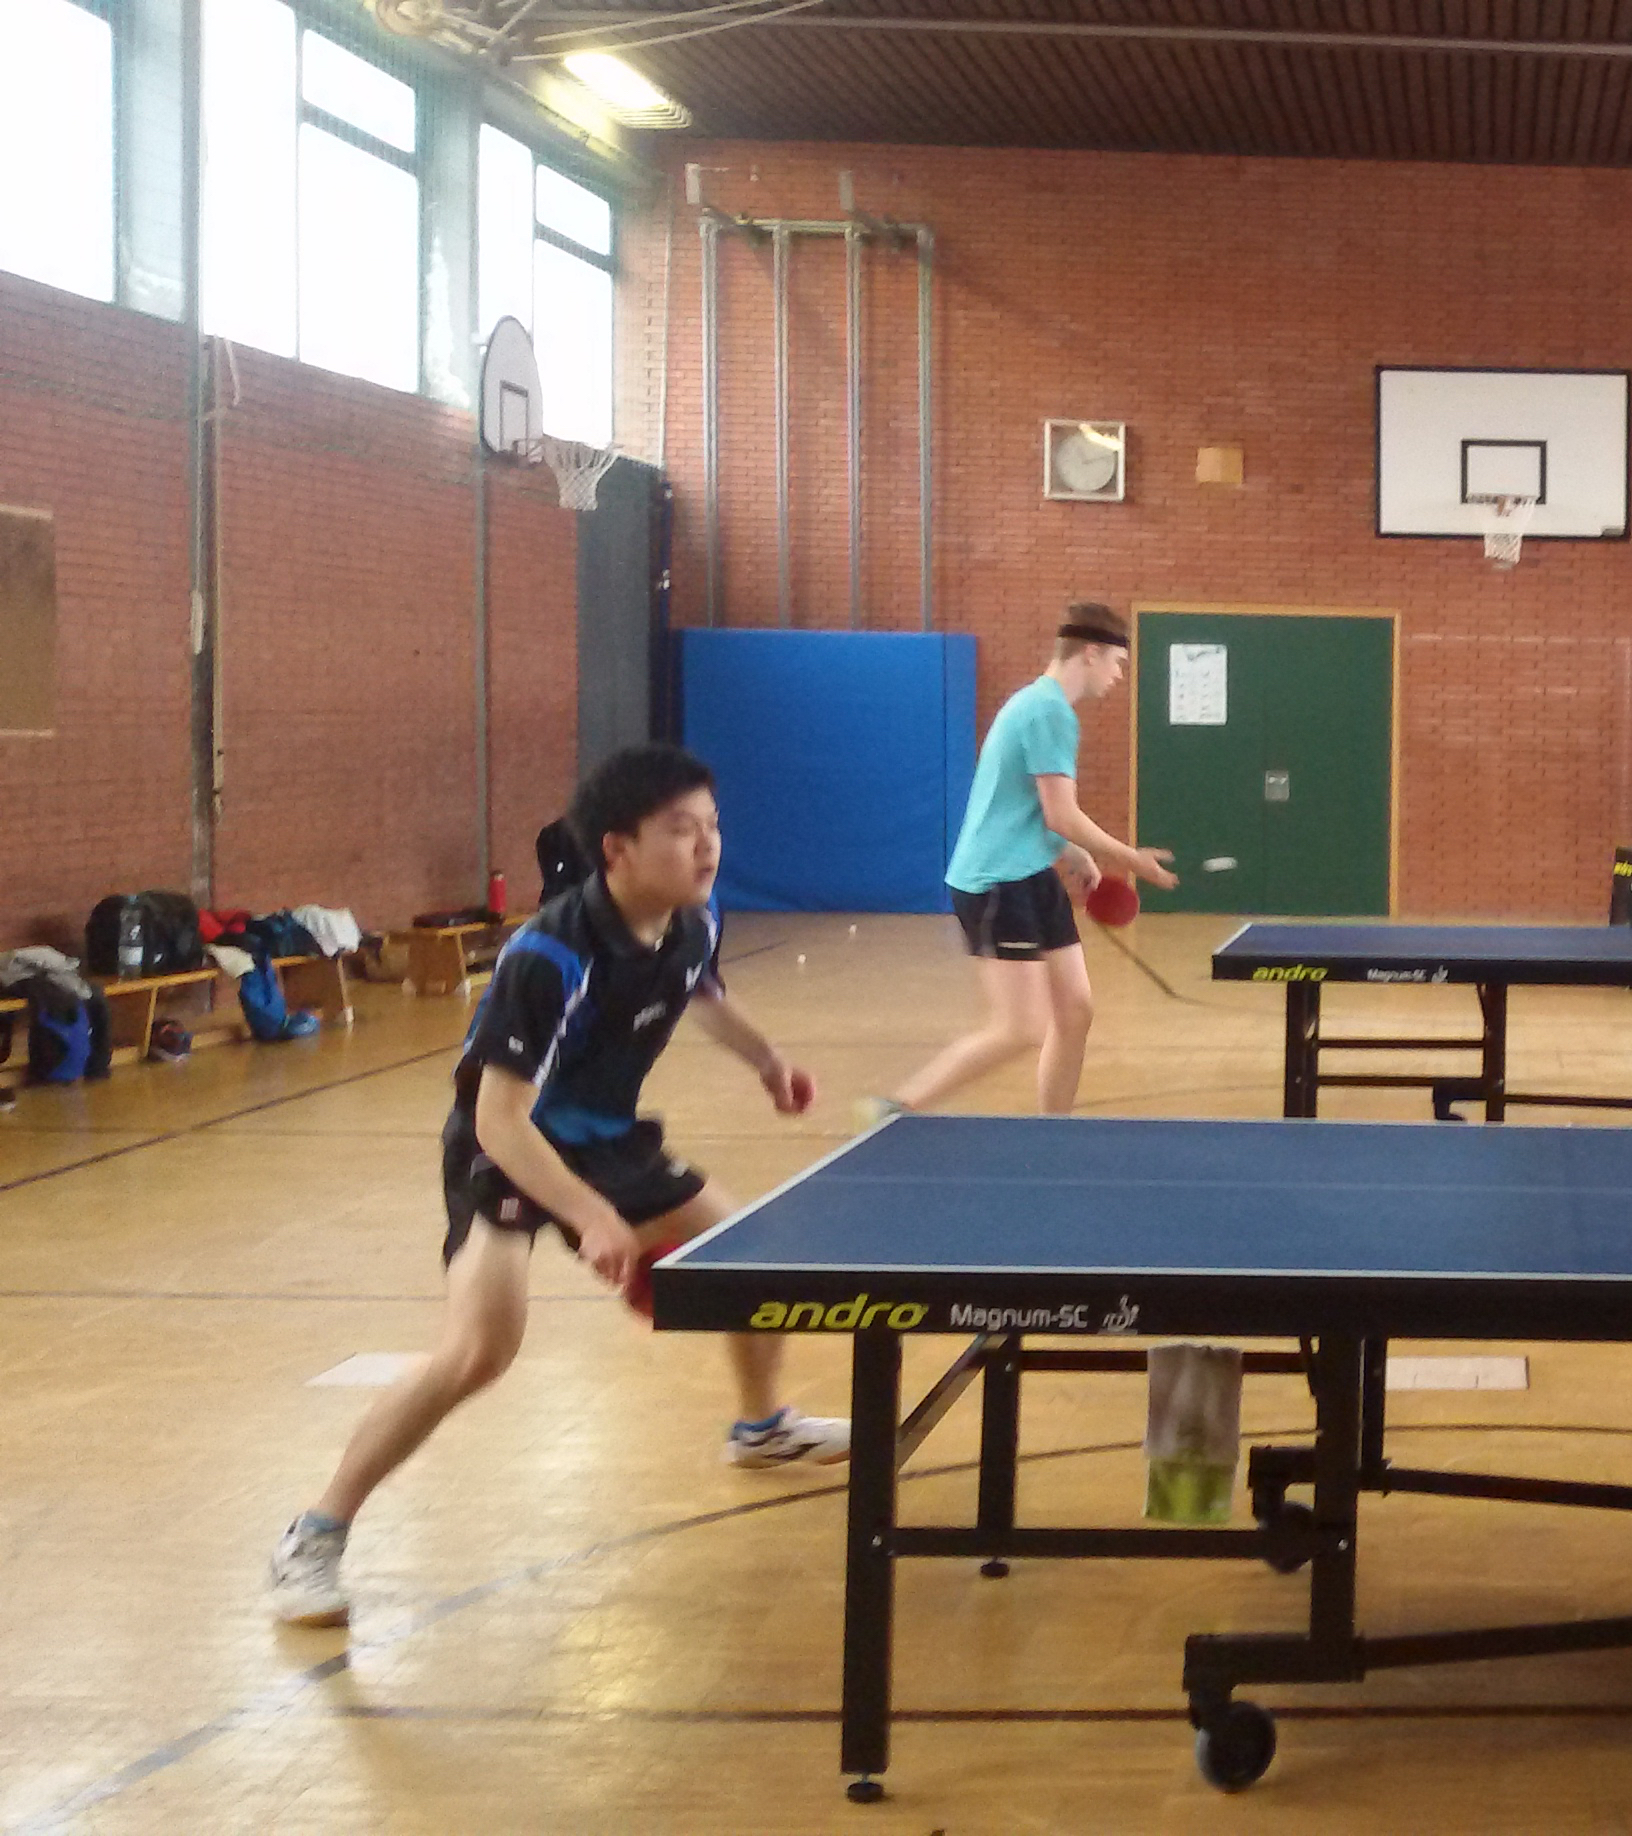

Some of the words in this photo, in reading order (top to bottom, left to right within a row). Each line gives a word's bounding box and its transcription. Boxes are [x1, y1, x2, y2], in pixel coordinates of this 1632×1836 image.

[1252, 963, 1329, 982] andro
[750, 1293, 929, 1330] andro
[950, 1303, 1089, 1332] Magnum-SC
